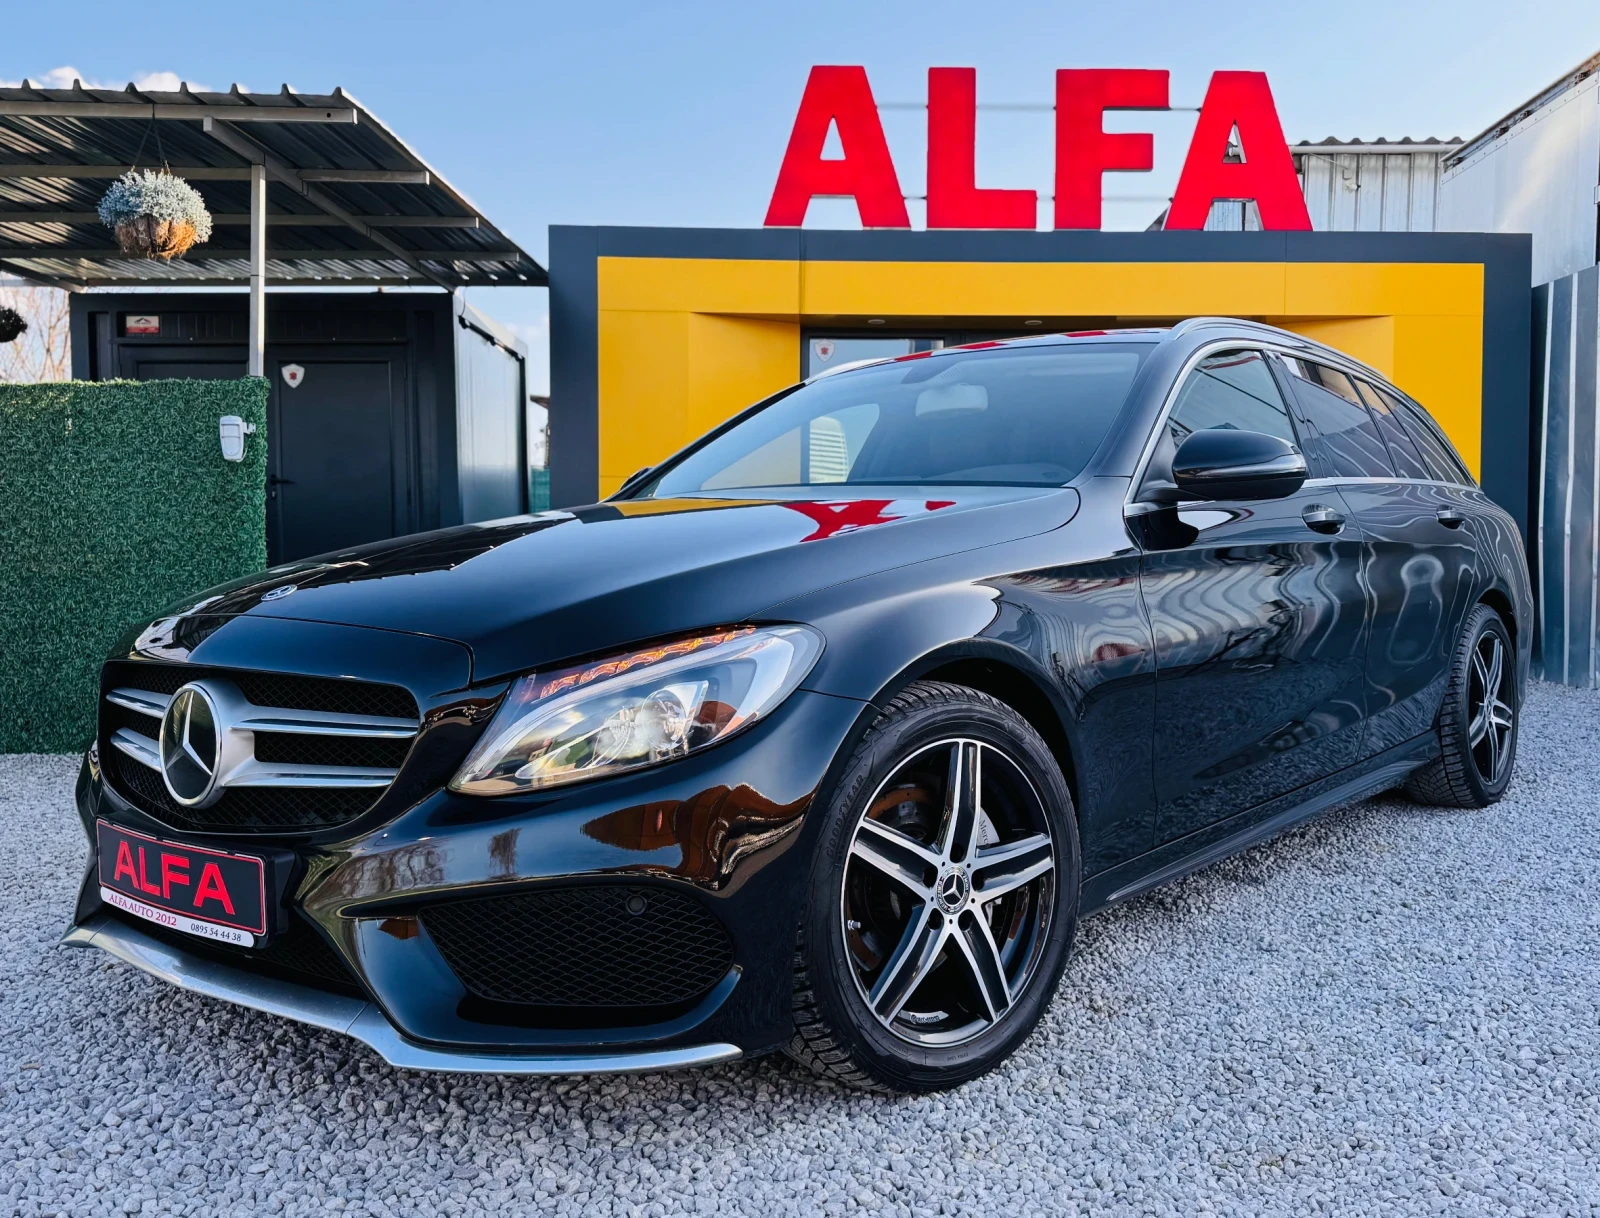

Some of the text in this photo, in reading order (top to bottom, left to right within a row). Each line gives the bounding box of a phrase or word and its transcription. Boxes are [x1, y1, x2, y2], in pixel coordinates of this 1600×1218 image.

[763, 65, 1313, 231] ALFA
[826, 774, 866, 860] GOODYEAR
[109, 893, 177, 927] ALFA AUTO 2012
[114, 839, 236, 916] ALFA
[190, 922, 242, 942] 0895 54 44 38
